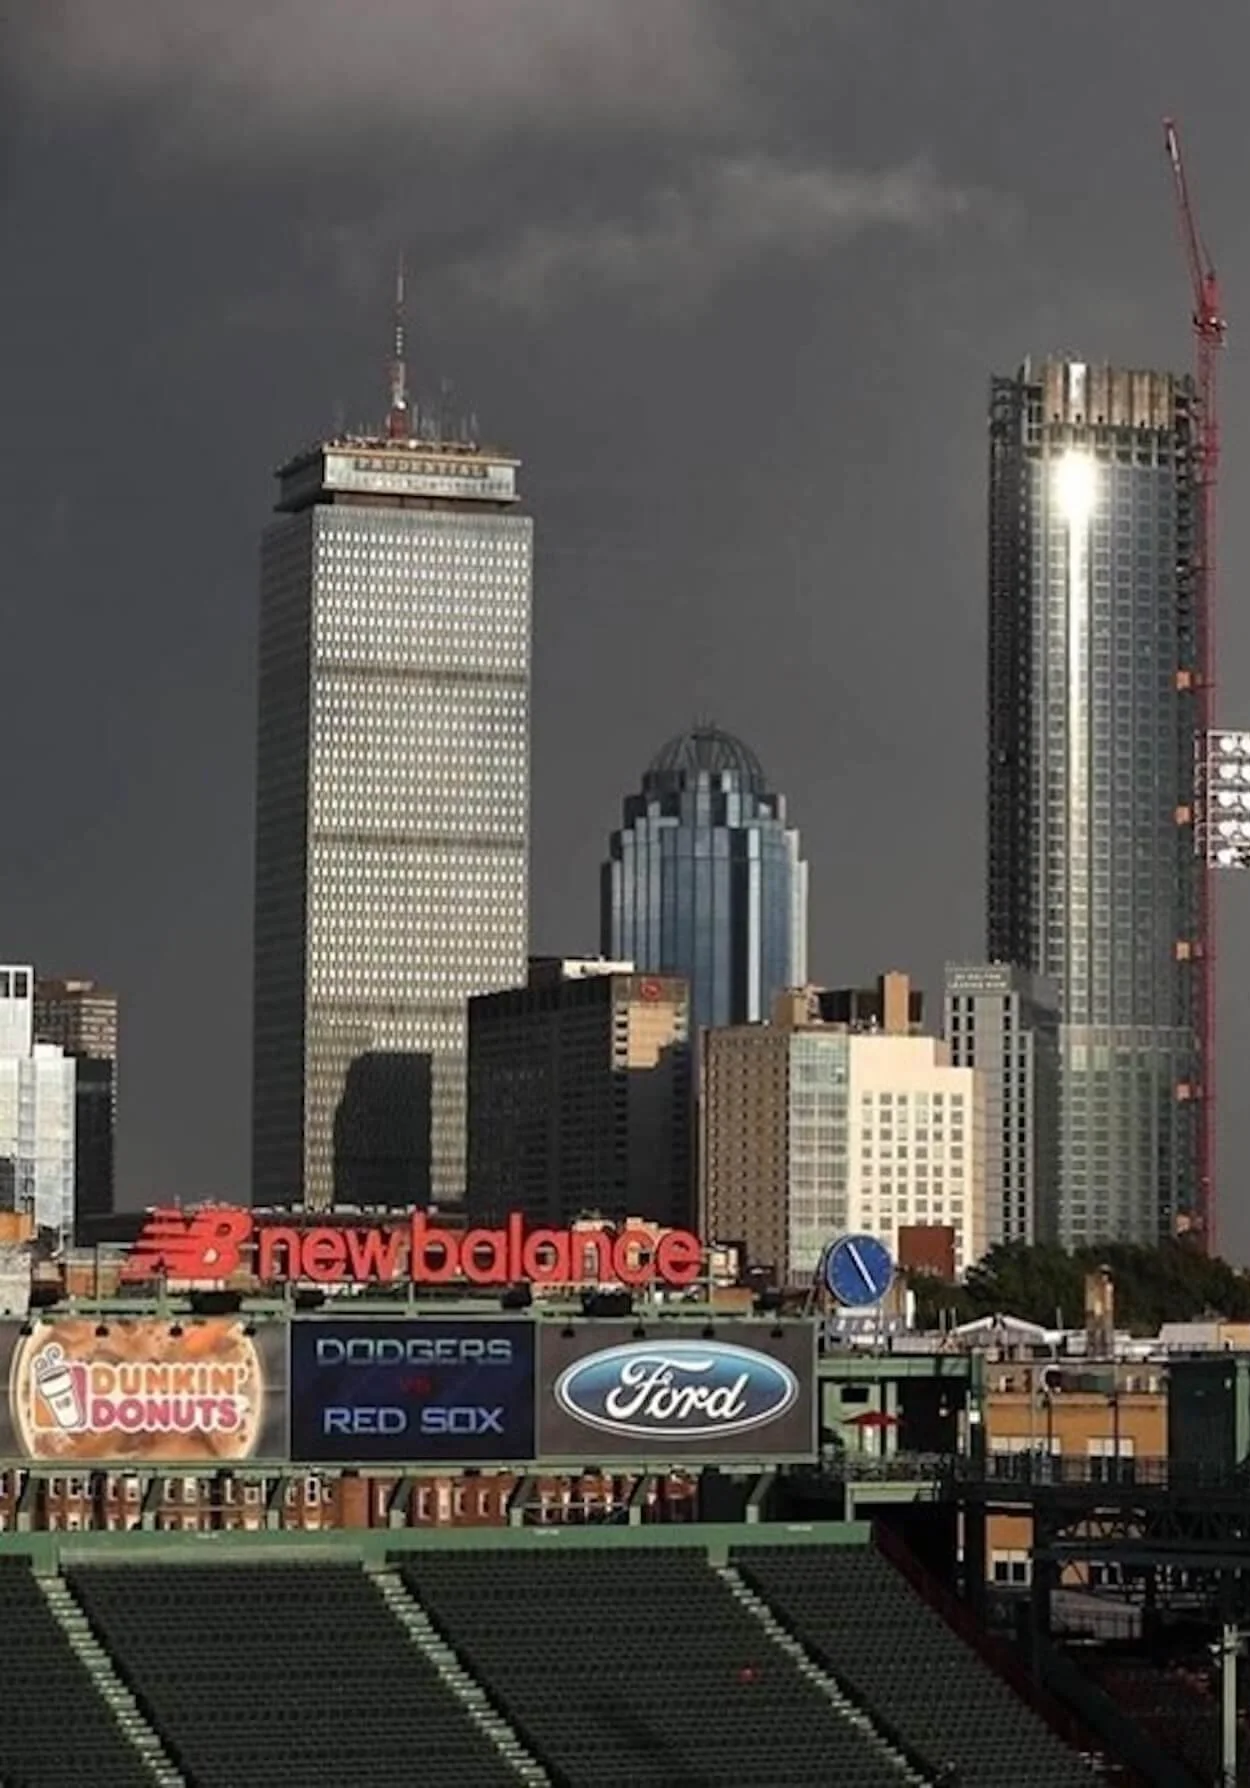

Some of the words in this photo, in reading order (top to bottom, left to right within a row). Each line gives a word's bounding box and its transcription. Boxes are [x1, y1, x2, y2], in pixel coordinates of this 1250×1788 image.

[259, 1226, 402, 1282] new
[411, 1211, 702, 1284] balance
[316, 1339, 512, 1366] DODGERS
[90, 1366, 248, 1395] DUNKIN'
[605, 1355, 749, 1420] Ford
[90, 1397, 239, 1429] DONUTS
[323, 1407, 407, 1434] RED
[420, 1407, 504, 1434] SOX
